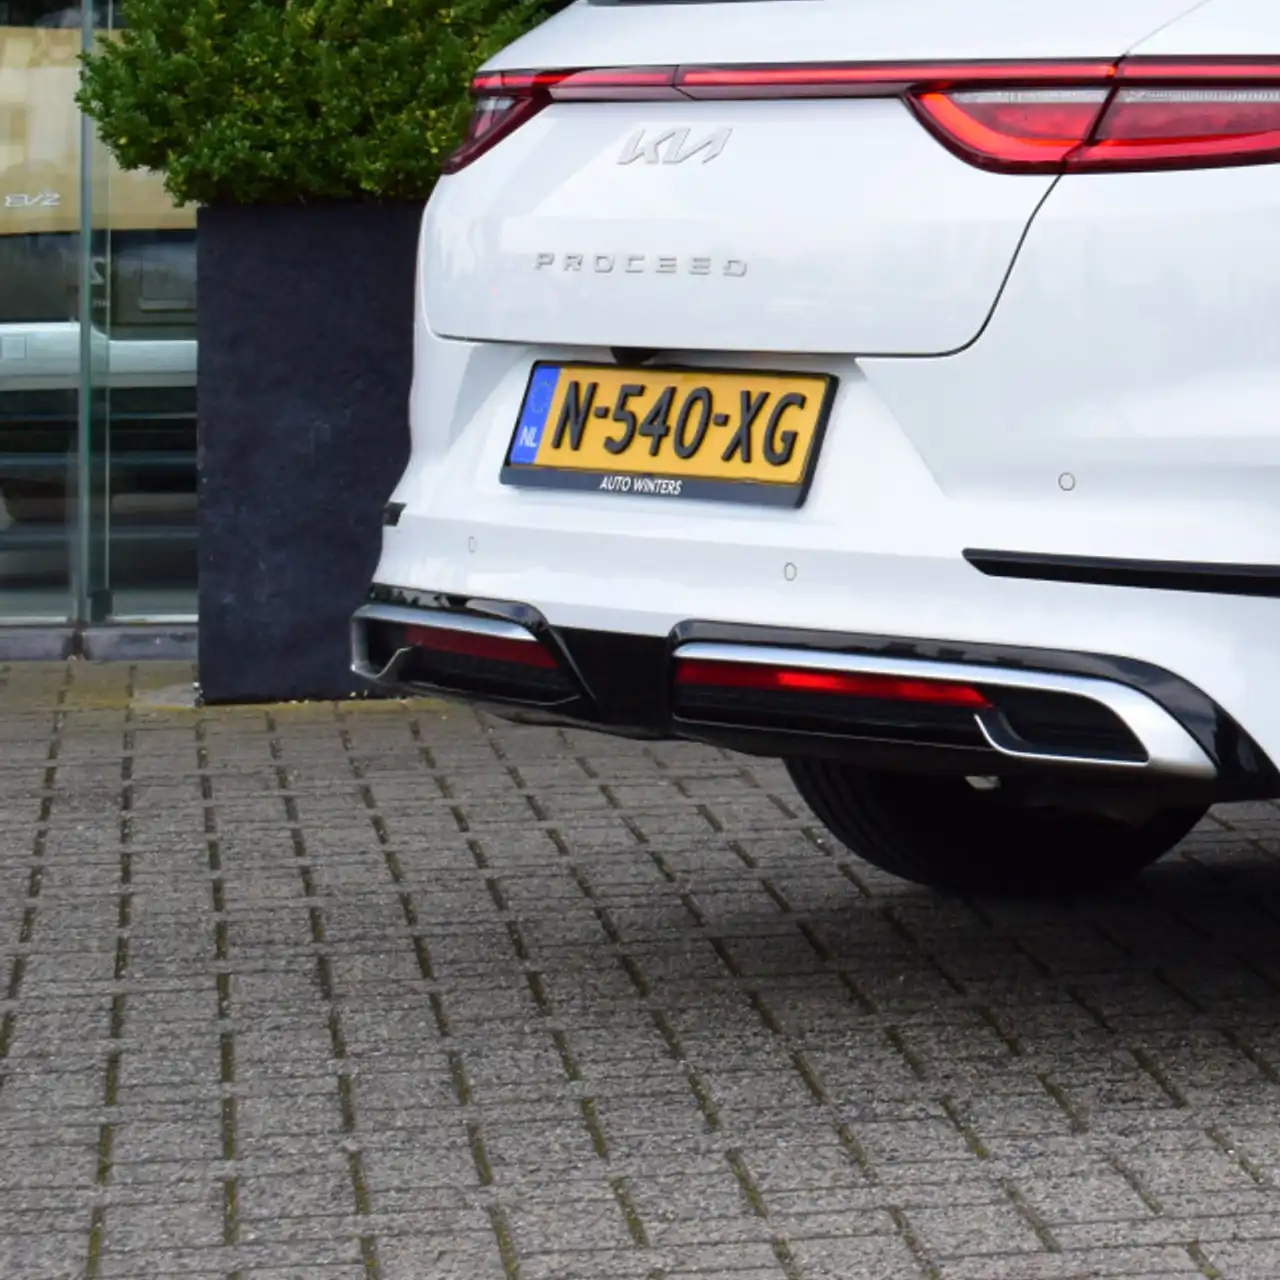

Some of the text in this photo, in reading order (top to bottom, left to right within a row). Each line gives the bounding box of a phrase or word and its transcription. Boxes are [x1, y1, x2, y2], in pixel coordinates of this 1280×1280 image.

[616, 127, 733, 165] KIA
[533, 252, 749, 278] PROCEED
[517, 380, 806, 467] NL N-540-XG
[600, 475, 684, 496] AUTO WINTERS
